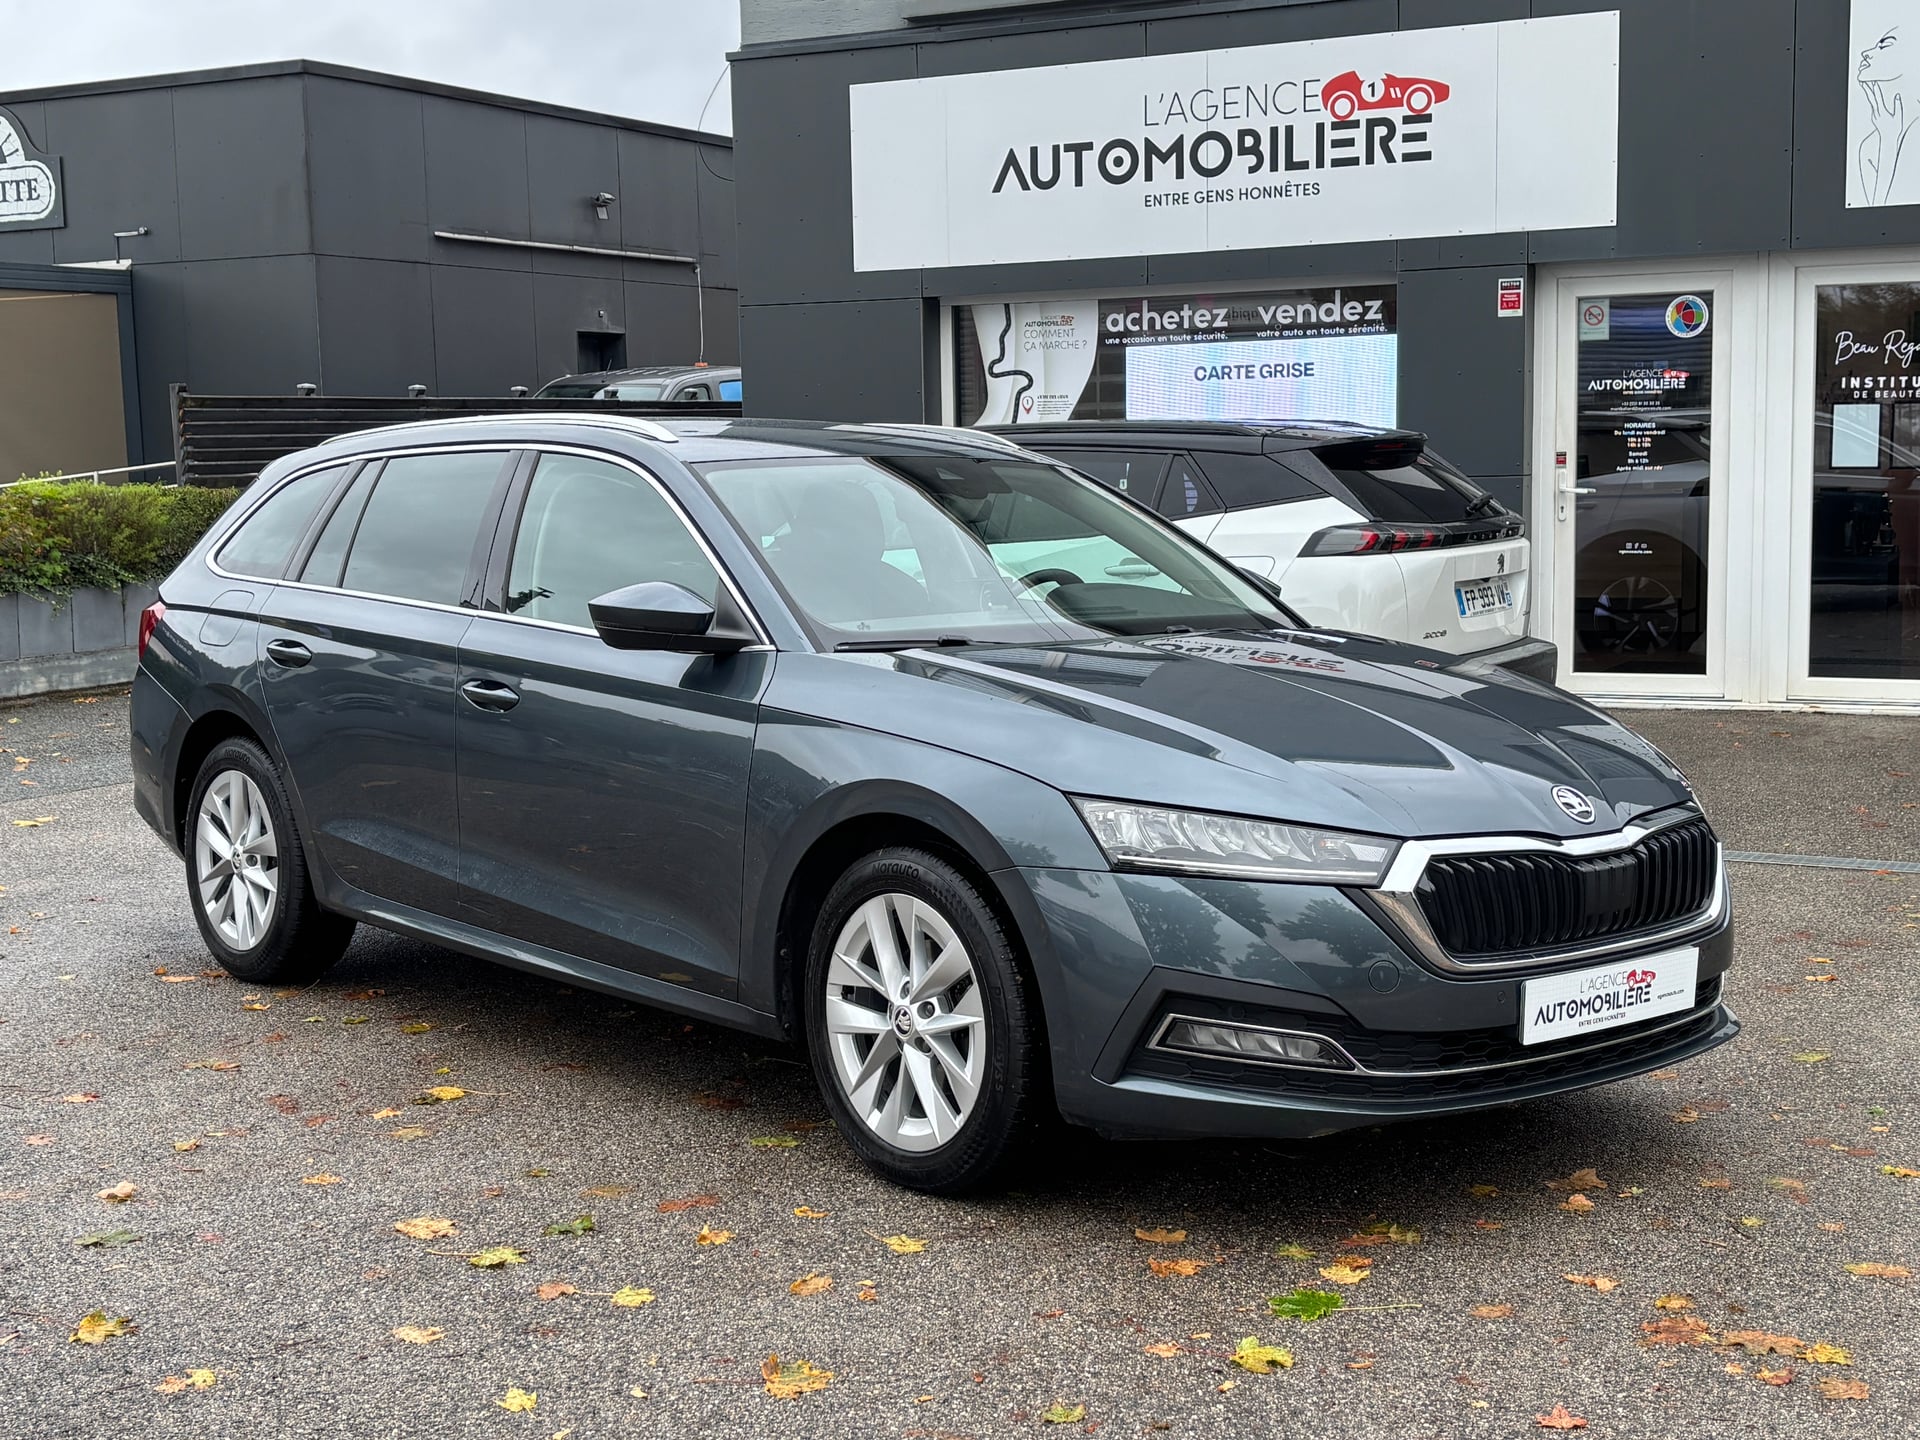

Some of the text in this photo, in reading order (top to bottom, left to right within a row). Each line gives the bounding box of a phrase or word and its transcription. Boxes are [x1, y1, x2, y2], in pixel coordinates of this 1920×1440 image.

[1367, 82, 1376, 97] 1
[1143, 78, 1322, 127] L'AGENCE
[1144, 181, 1321, 208] ENTRE GENS HONNÊTES
[1106, 289, 1384, 333] achetez vendez
[1024, 328, 1075, 339] COMMENT
[1122, 335, 1156, 344] occasion
[1169, 333, 1192, 341] toute
[1256, 330, 1280, 338] votre
[1282, 328, 1304, 337] auto
[1320, 326, 1345, 335] toute
[1348, 323, 1388, 334] sérénité.
[1039, 340, 1080, 350] MARCHE
[1835, 331, 1878, 365] Beau
[1194, 362, 1315, 382] CARTE GRISE
[1623, 369, 1663, 378] L'AGENCE
[1853, 390, 1868, 398] DE
[871, 861, 920, 879] Norauto
[1580, 971, 1628, 993] L'AGENCE
